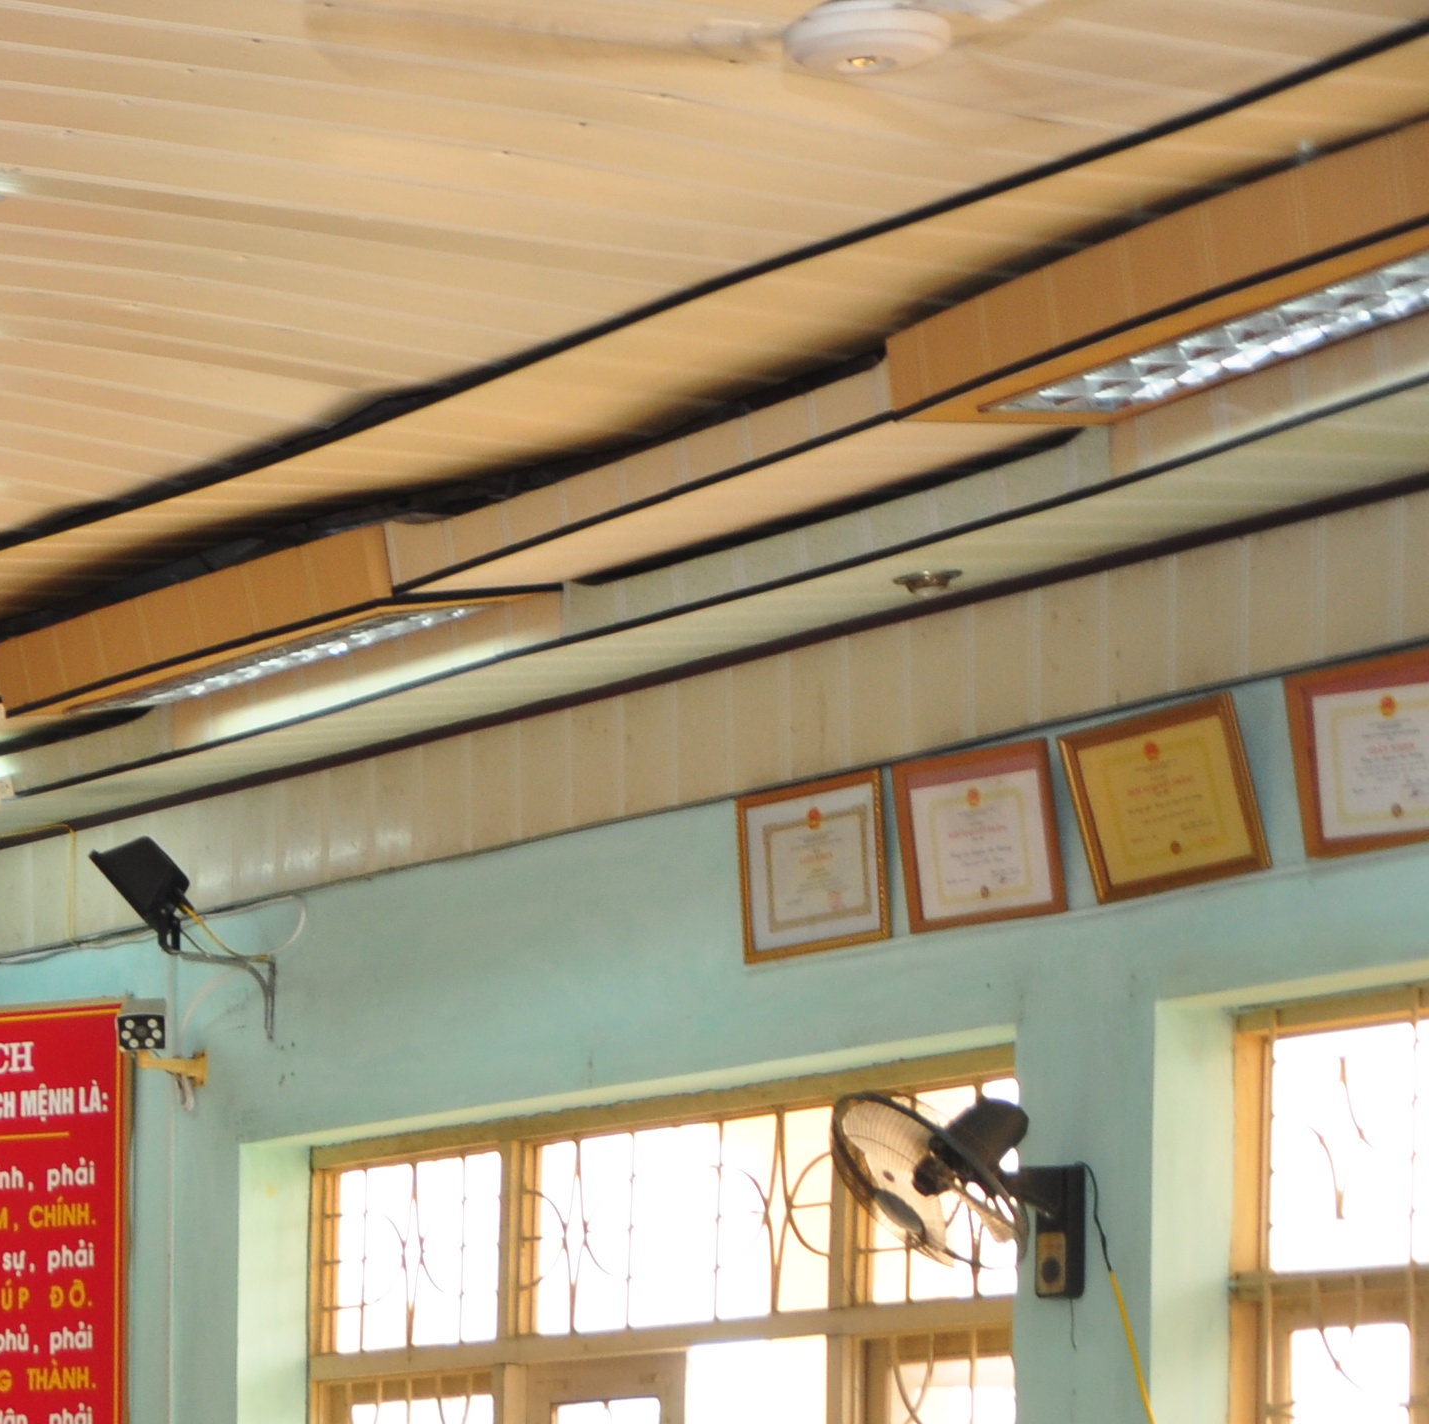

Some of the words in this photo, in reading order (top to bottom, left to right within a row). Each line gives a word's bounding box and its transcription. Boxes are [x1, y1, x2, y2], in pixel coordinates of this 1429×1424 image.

[20, 1084, 74, 1122] MỆNH
[79, 1080, 108, 1113] LÀ:
[46, 1157, 95, 1191] phải
[29, 1197, 96, 1228] CHÍNH.
[2, 1250, 35, 1278] sự,
[46, 1239, 94, 1272] phải
[49, 1321, 92, 1354] phải
[27, 1359, 96, 1391] THÀNH.
